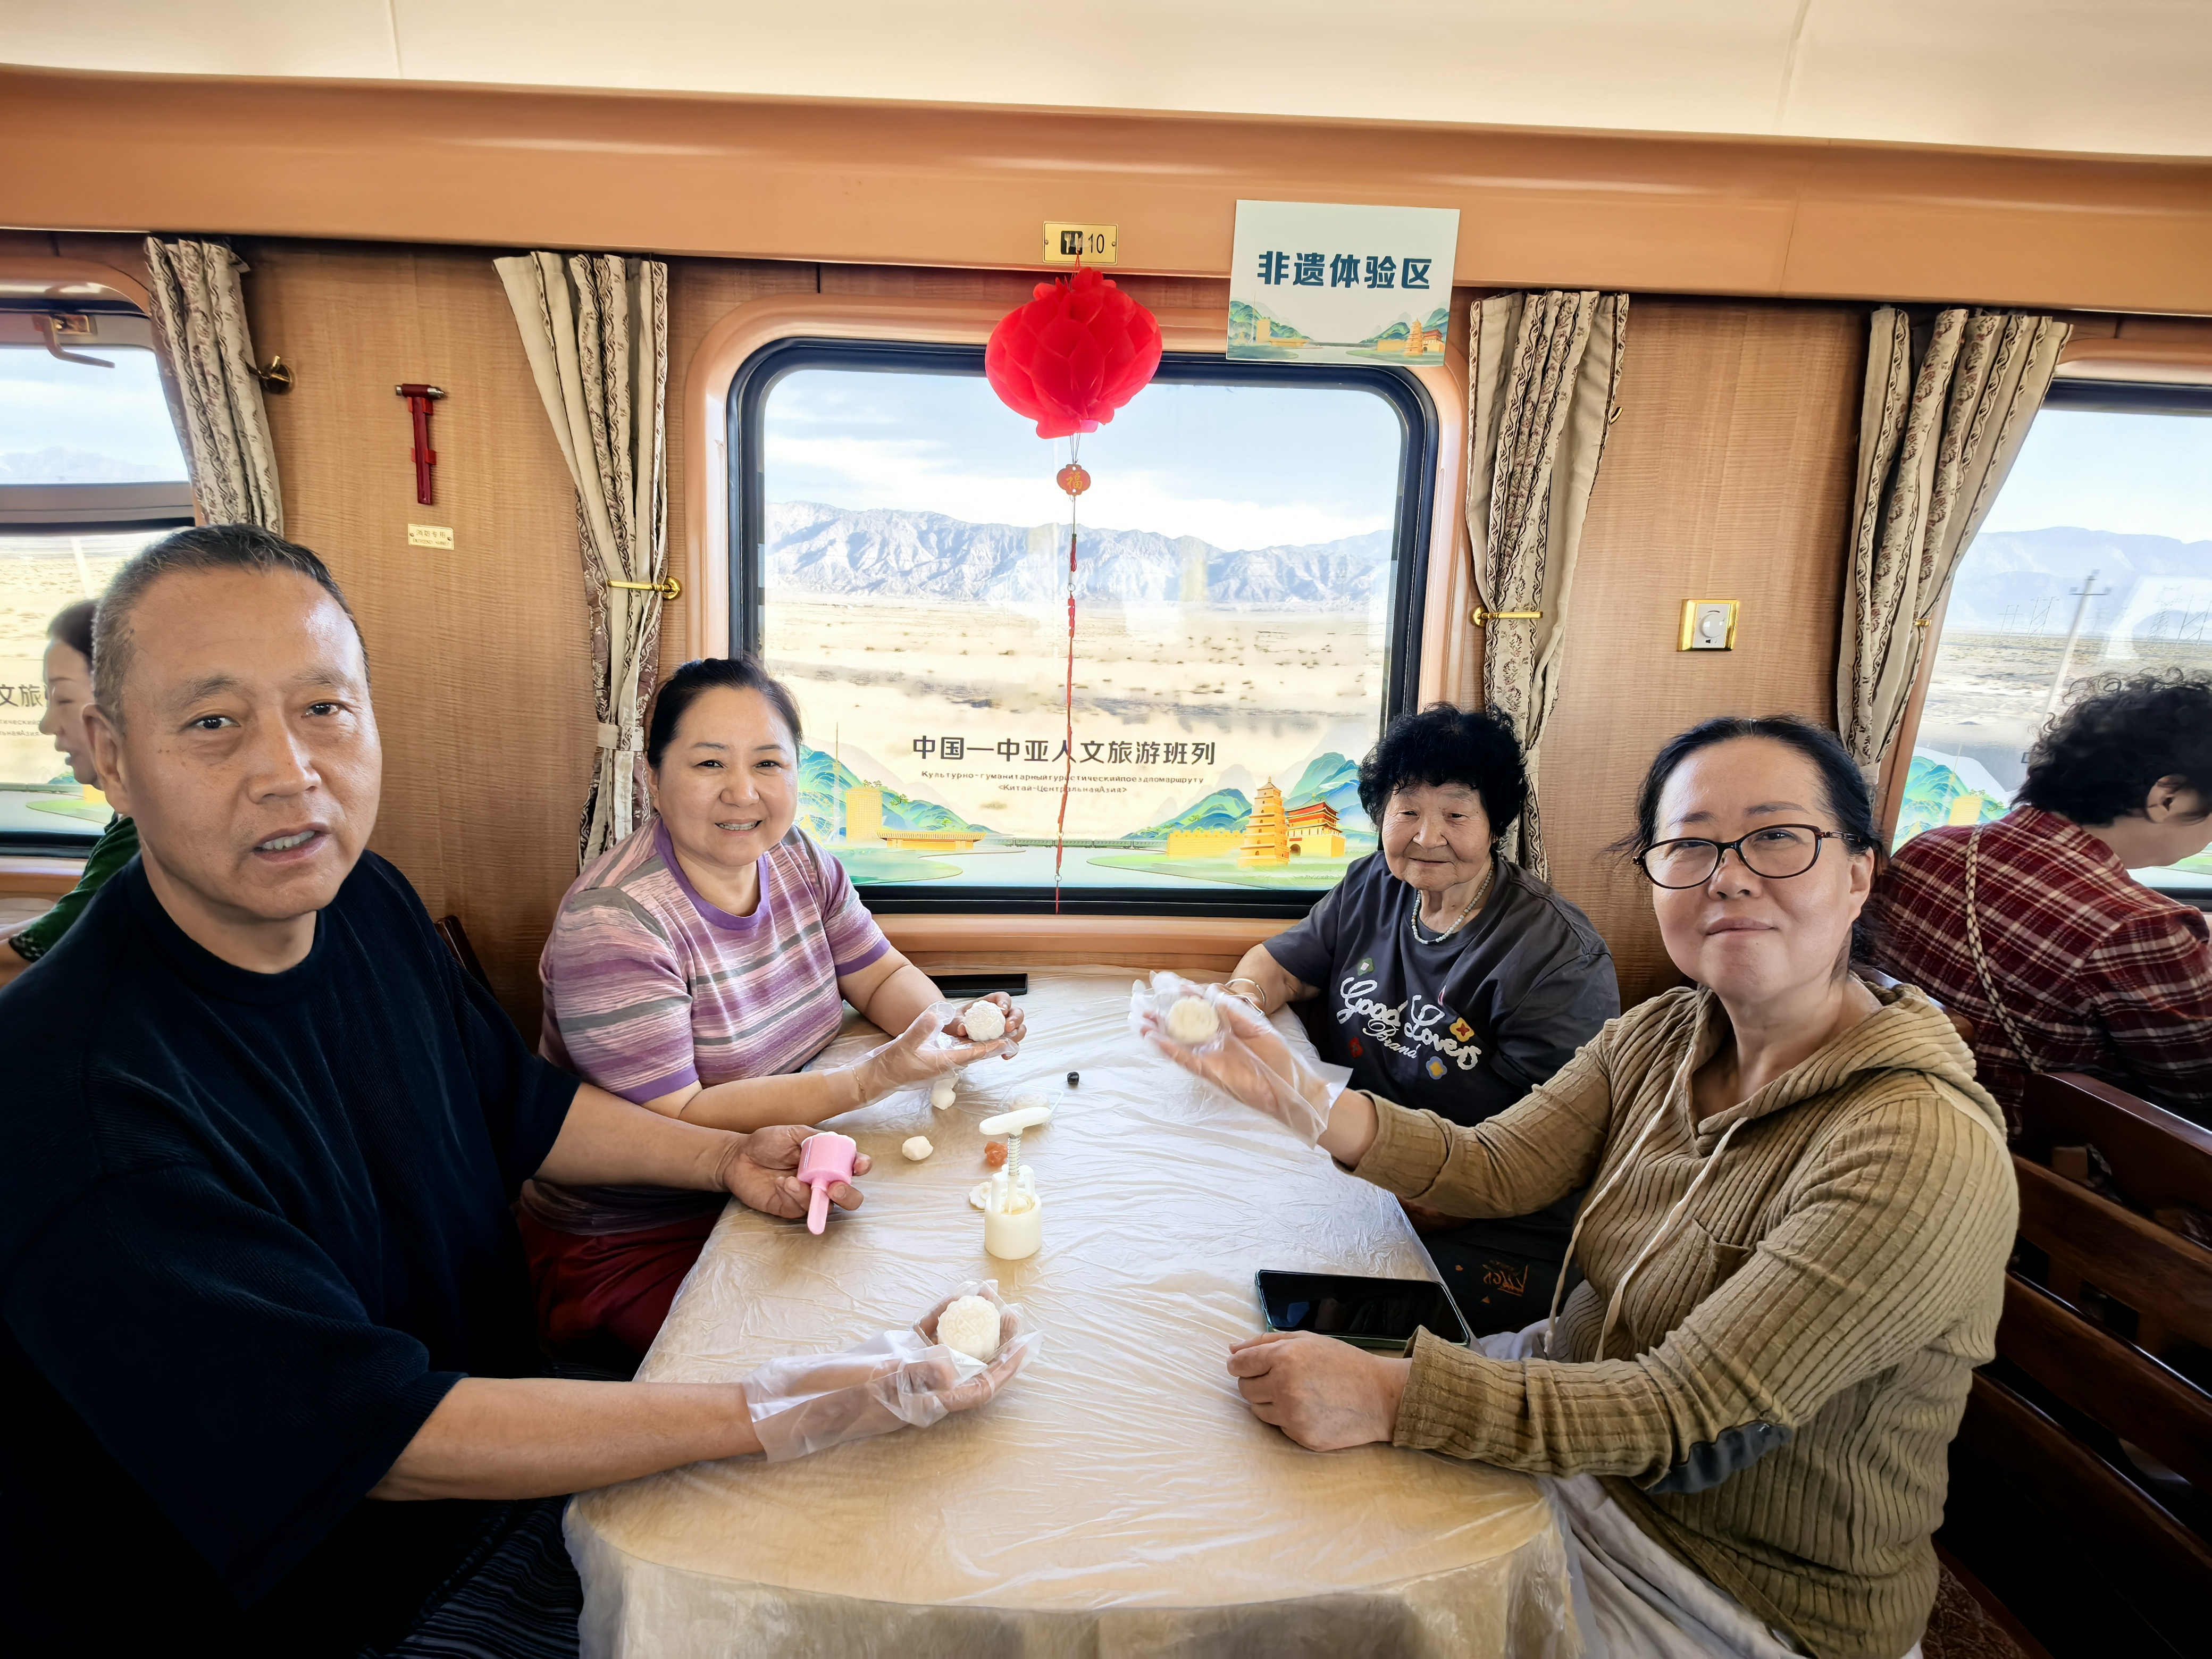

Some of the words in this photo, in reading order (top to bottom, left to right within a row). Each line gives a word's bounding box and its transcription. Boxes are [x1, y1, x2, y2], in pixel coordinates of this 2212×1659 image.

[1088, 233, 1104, 254] 10
[1257, 250, 1432, 290] 非遗体验区
[1065, 471, 1083, 489] 福
[0, 684, 48, 707] 文旅
[1336, 977, 1409, 1027] Good
